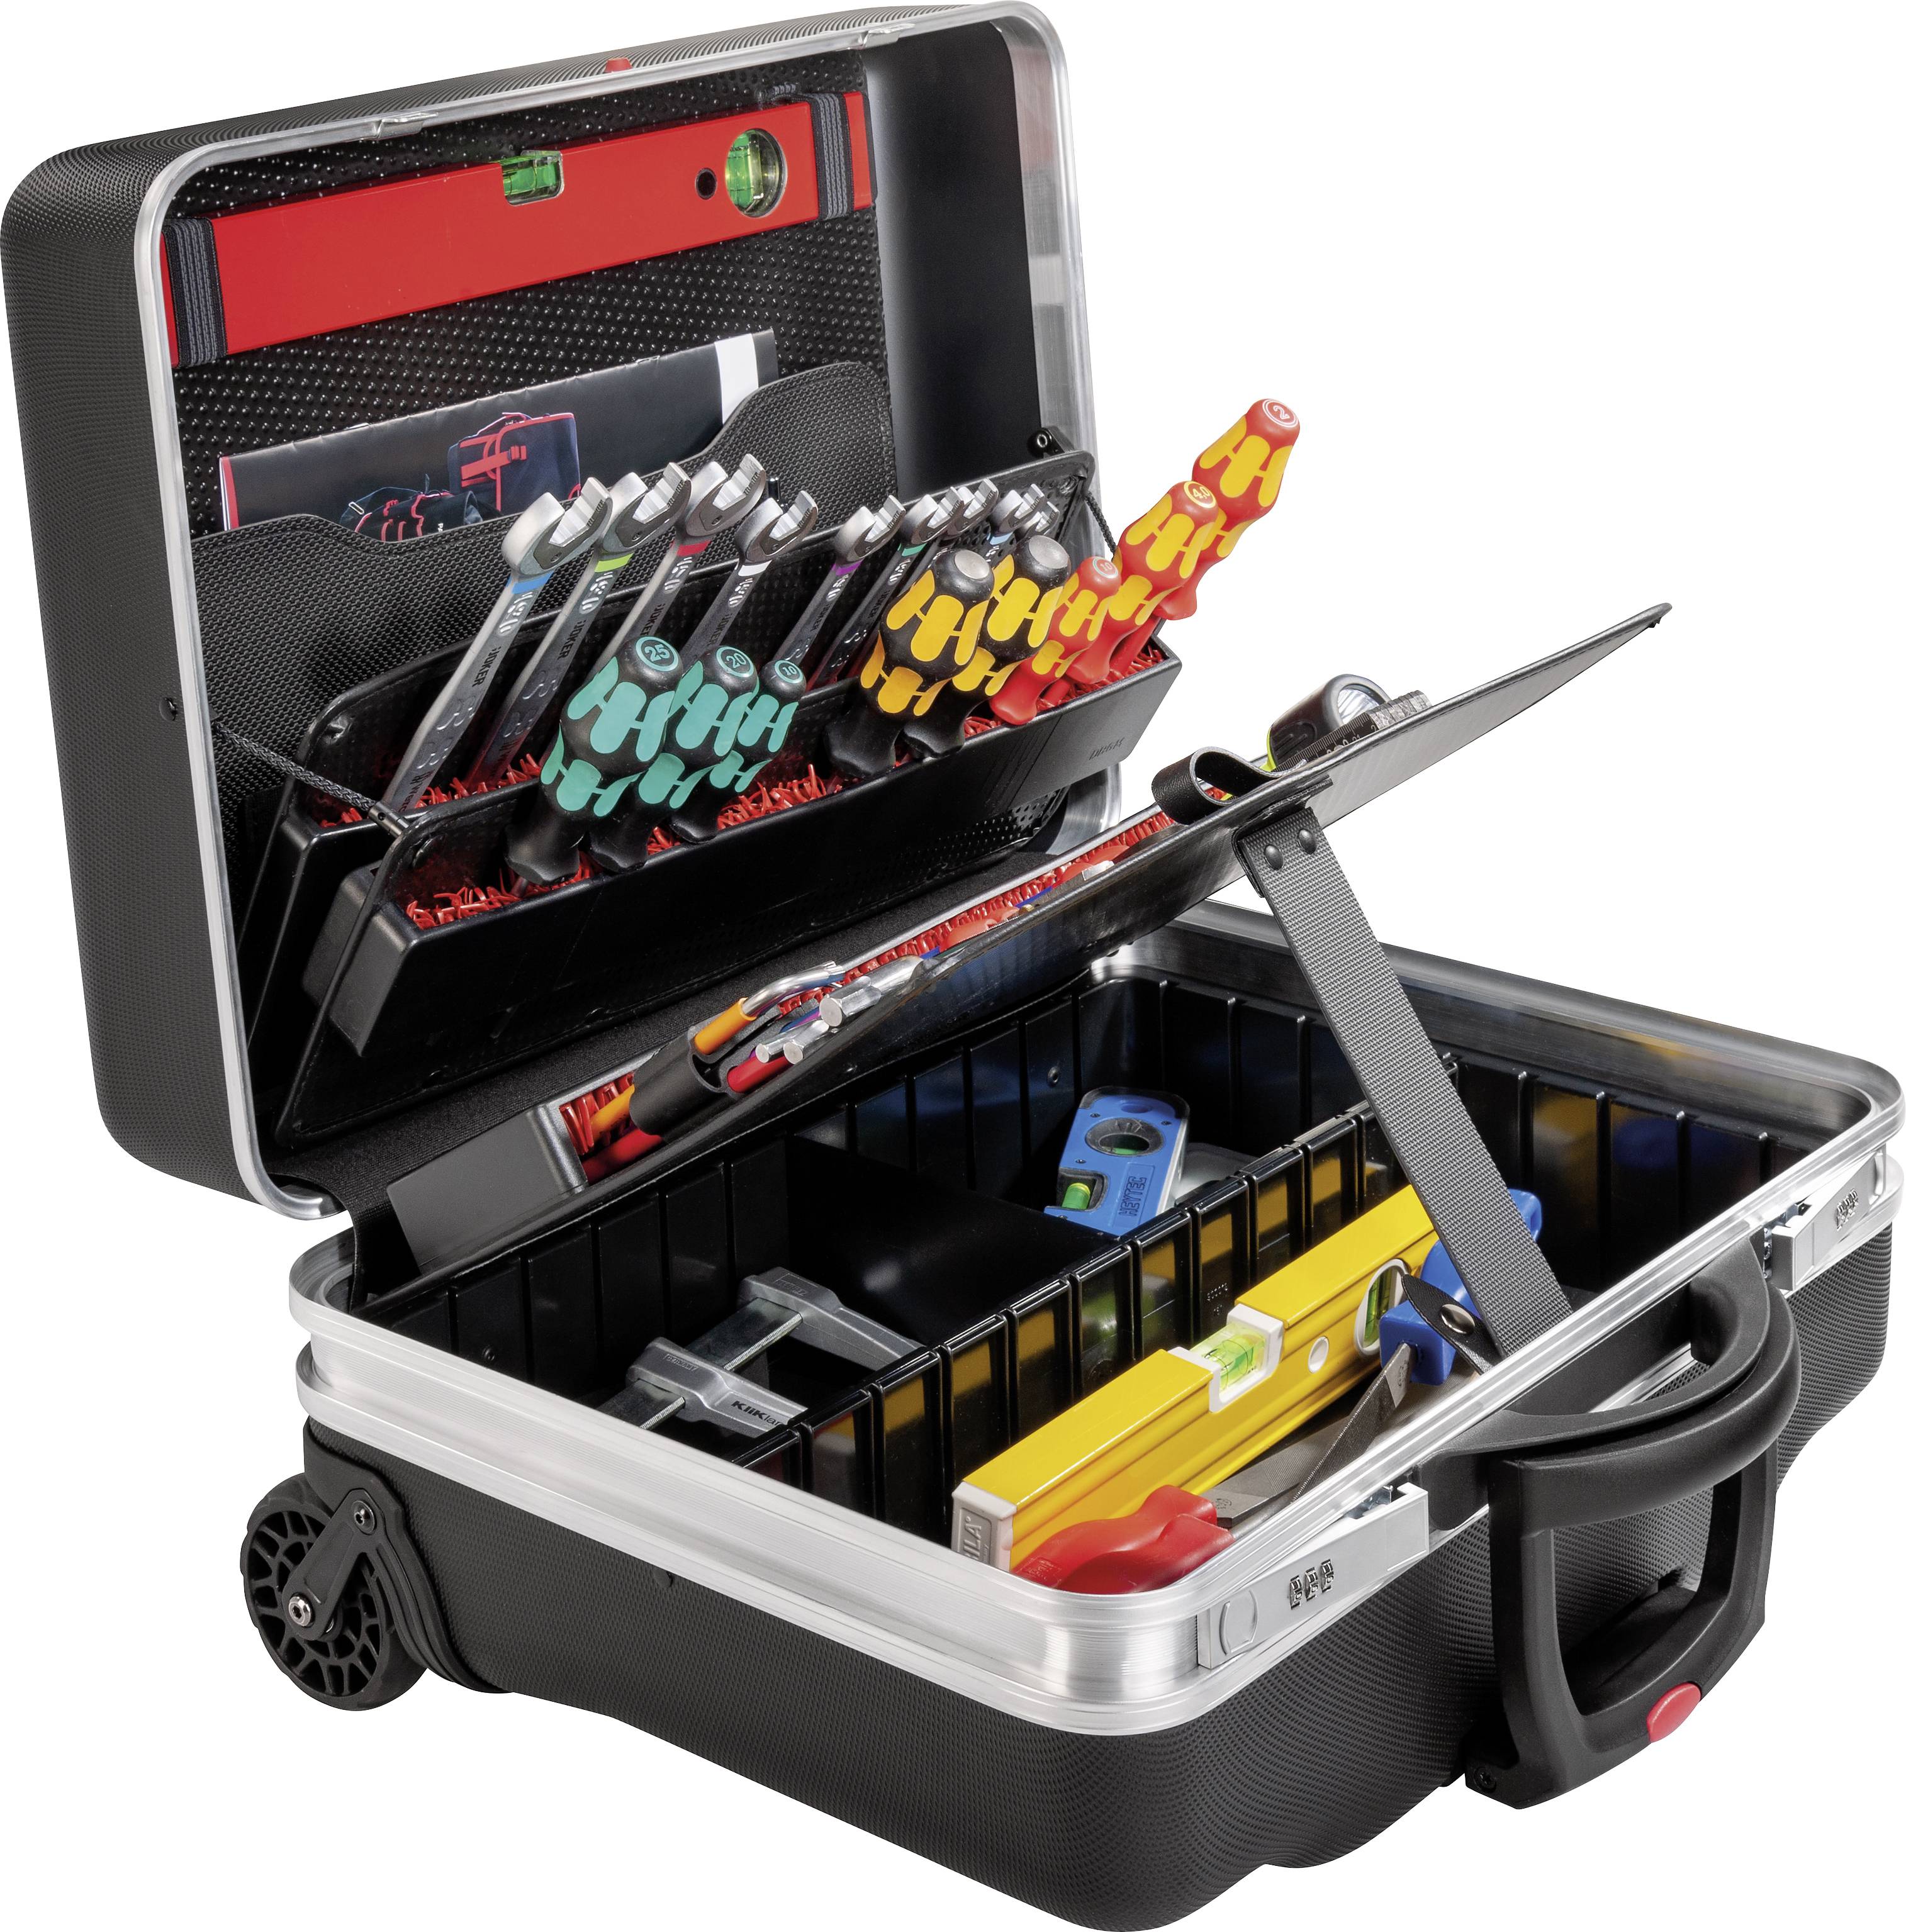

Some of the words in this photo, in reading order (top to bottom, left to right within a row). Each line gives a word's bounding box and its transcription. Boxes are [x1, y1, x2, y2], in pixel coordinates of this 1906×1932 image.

[1273, 405, 1290, 420] 2
[1100, 562, 1113, 572] 10
[557, 620, 586, 661] JOKER
[644, 644, 670, 662] 25
[726, 652, 747, 669] 20
[472, 647, 502, 688] JOKER
[782, 666, 797, 676] 10
[1118, 1176, 1147, 1217] HEYTEC
